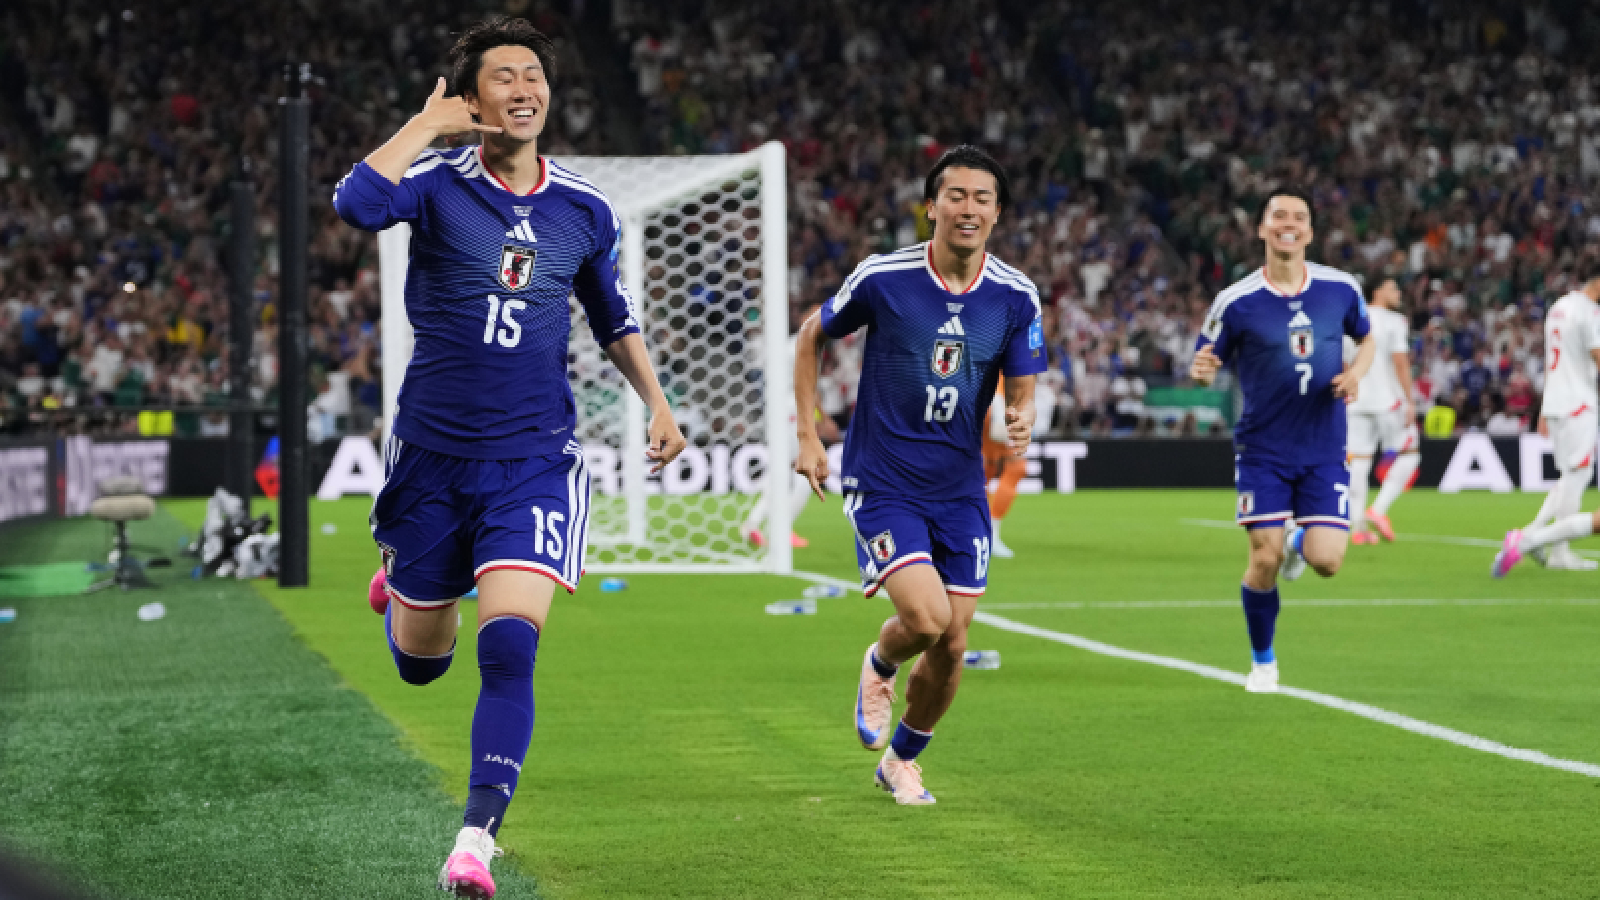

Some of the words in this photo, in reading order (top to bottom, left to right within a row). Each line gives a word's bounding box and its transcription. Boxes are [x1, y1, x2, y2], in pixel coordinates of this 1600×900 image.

[484, 294, 527, 348] 15
[1294, 362, 1313, 396] 7
[924, 385, 959, 422] 13
[1333, 482, 1349, 515] 7
[531, 506, 565, 560] 15
